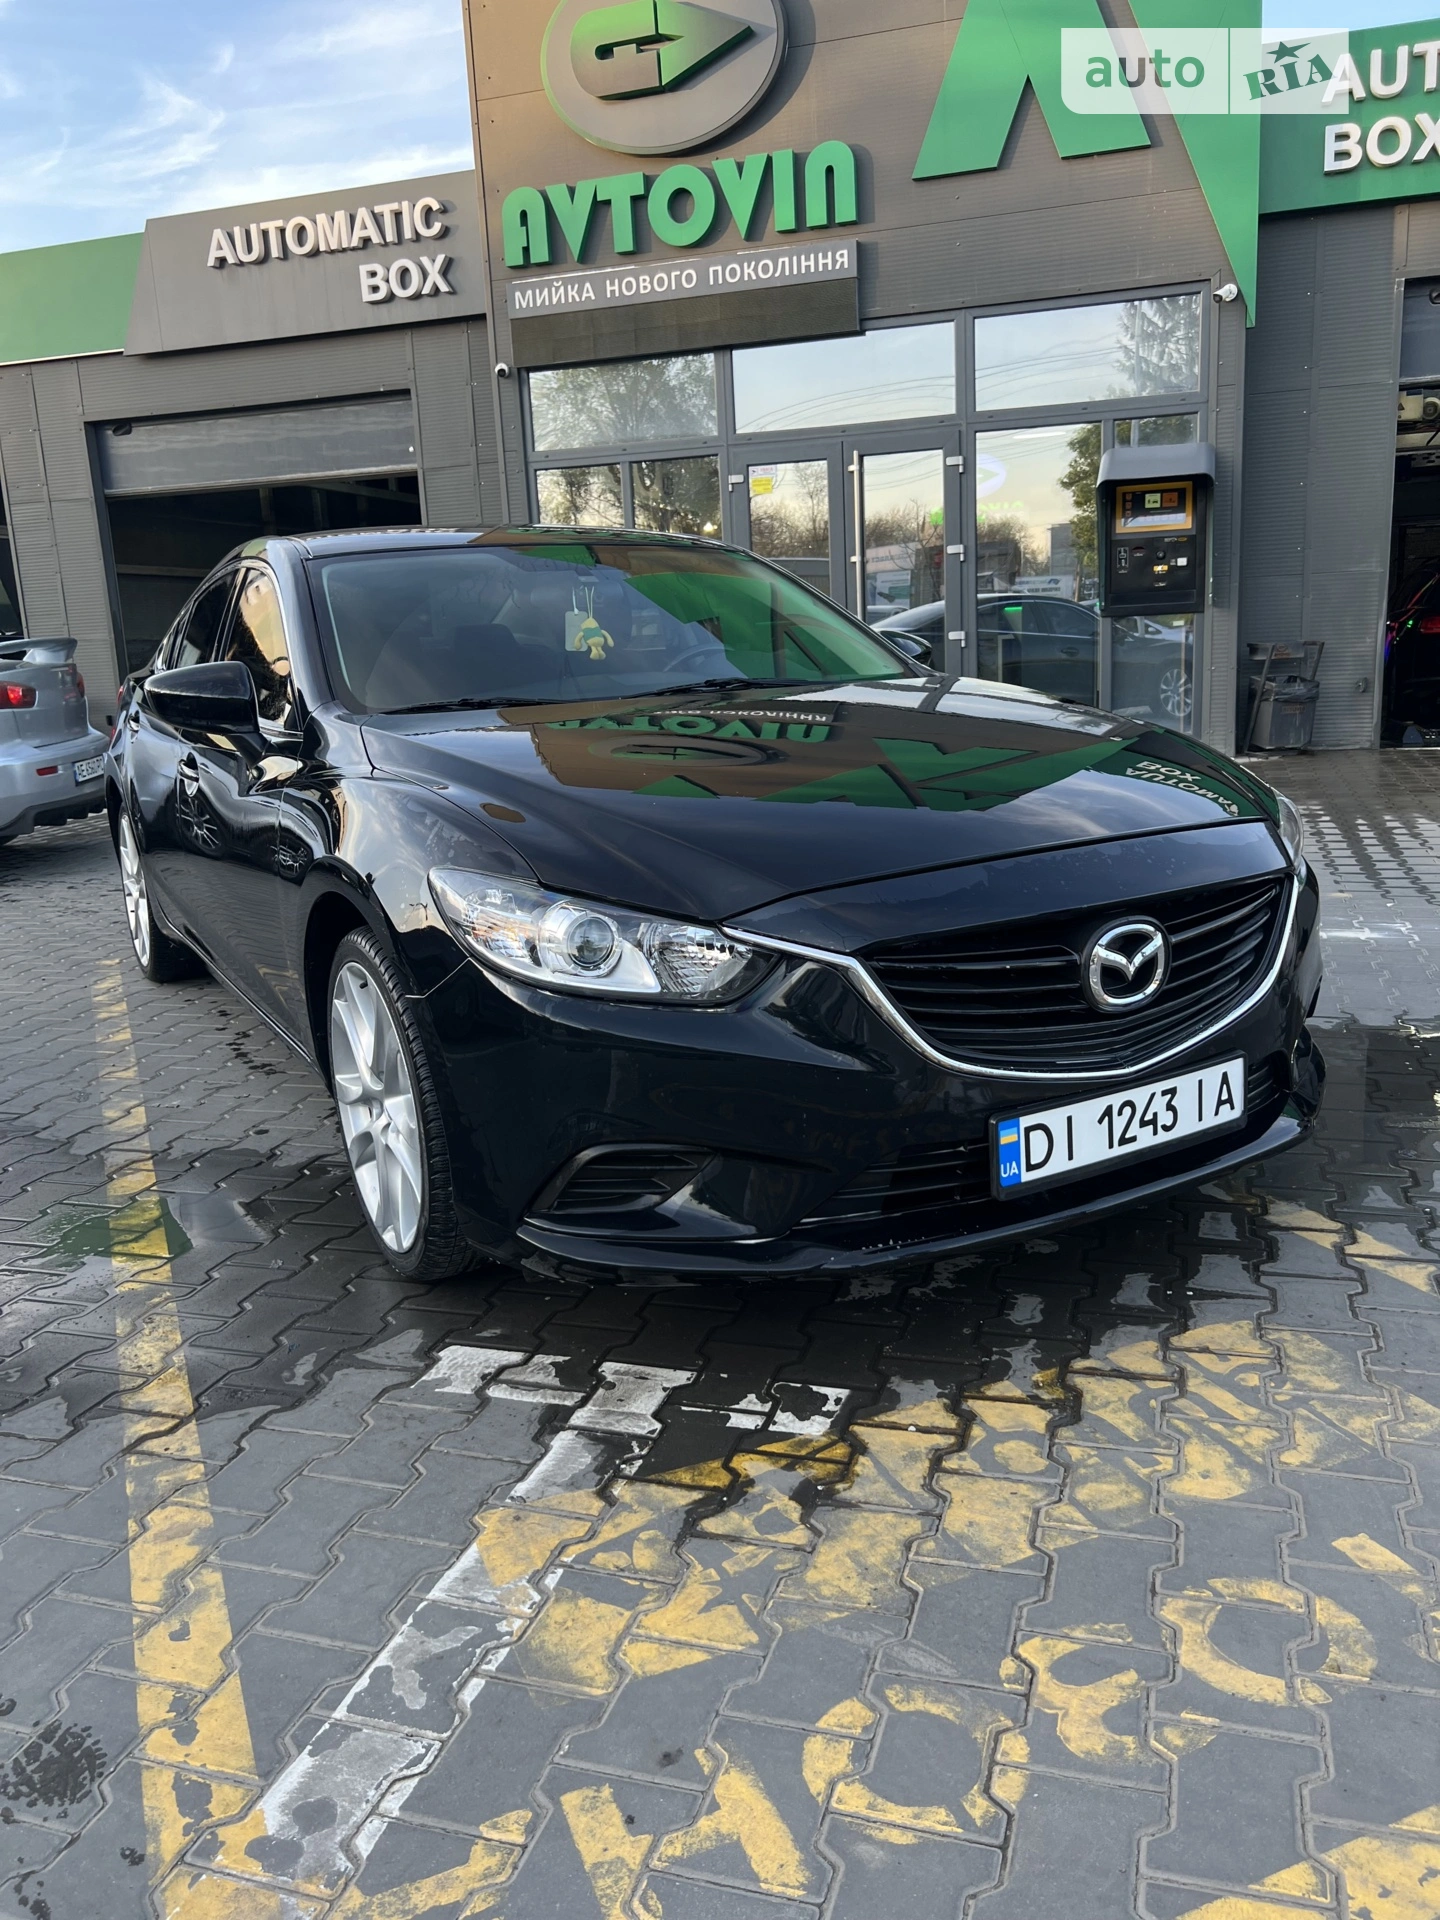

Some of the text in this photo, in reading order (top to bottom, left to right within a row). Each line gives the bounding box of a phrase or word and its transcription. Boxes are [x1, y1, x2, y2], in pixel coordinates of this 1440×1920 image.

[1323, 113, 1440, 175] BOX
[206, 197, 446, 268] AUTOMATIC
[358, 253, 453, 304] BOX
[514, 250, 850, 310] МИЙКА НОВОГО ПОКОЛІННЯ
[1024, 1071, 1235, 1172] DI 1243 IA
[1000, 1160, 1019, 1178] UA
